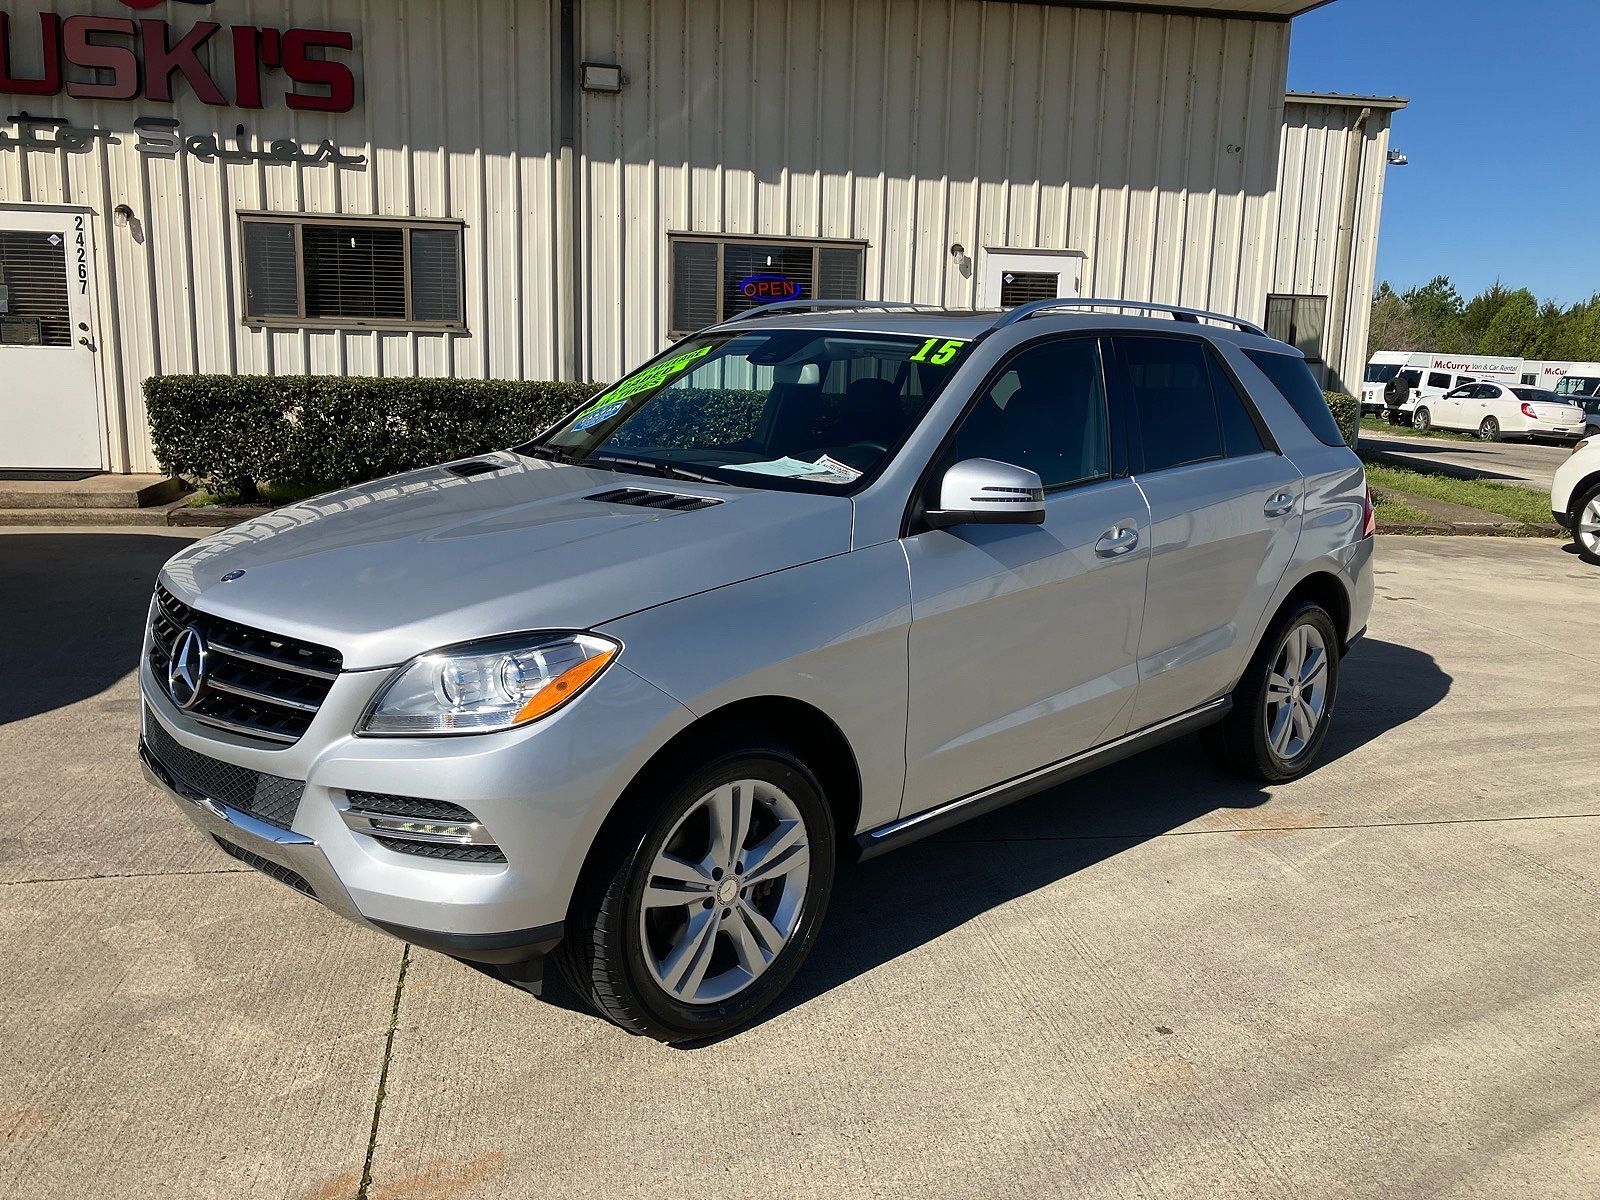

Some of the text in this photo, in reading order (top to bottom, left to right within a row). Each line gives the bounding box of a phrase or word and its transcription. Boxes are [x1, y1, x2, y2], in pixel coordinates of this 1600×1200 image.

[0, 111, 366, 164] to Sales
[74, 215, 87, 295] 24267
[744, 281, 795, 297] OPEN
[910, 338, 965, 365] 15
[1434, 360, 1471, 373] McCurry
[1500, 364, 1519, 372] Rental
